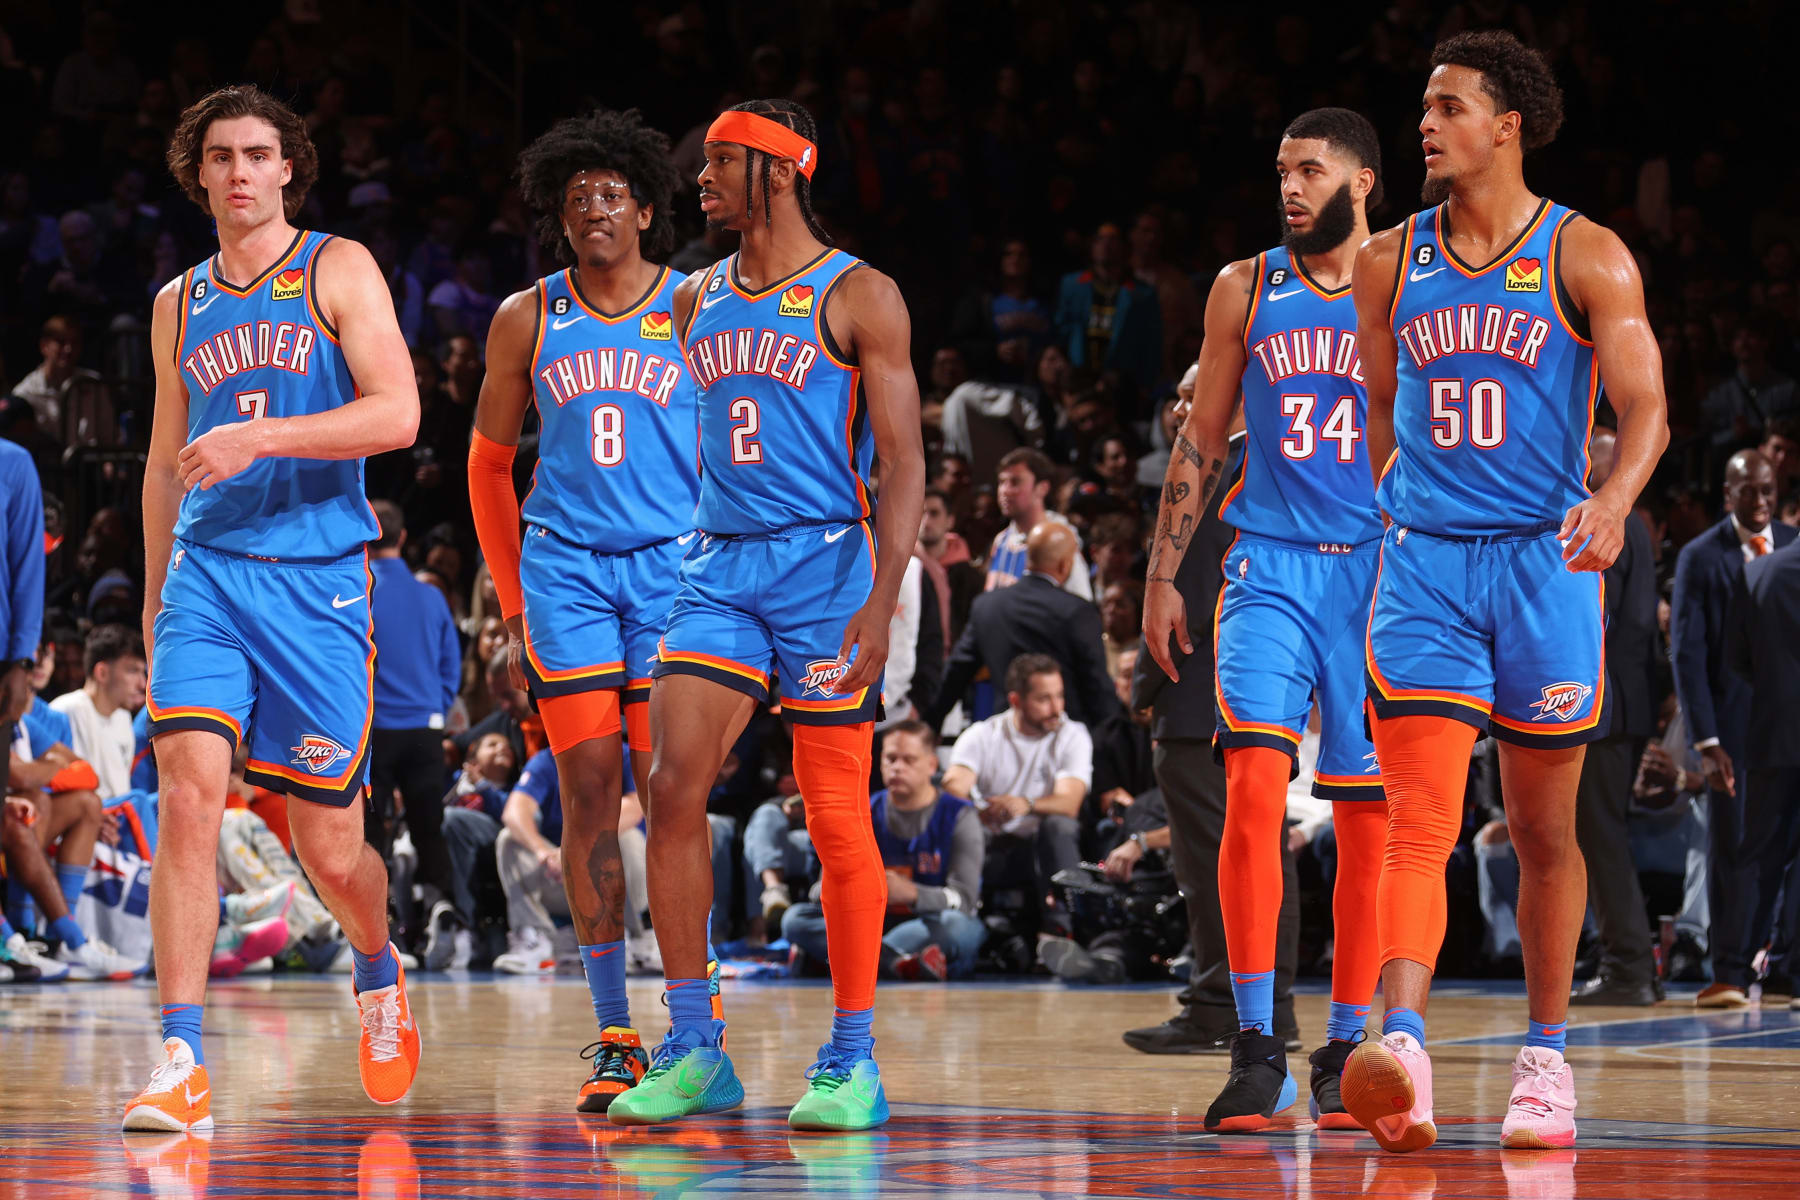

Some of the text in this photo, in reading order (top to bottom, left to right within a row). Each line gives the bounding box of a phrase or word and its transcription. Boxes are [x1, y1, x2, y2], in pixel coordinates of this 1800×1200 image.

[1418, 246, 1431, 263] 6
[710, 277, 722, 291] 6
[1272, 271, 1284, 283] 6
[1507, 279, 1540, 291] Love's
[194, 282, 206, 298] 6
[555, 299, 567, 313] 6
[1398, 304, 1551, 369] THUNDER
[184, 322, 316, 395] THUNDER
[690, 328, 818, 391] THUNDER
[540, 348, 680, 407] THUNDER
[1429, 378, 1506, 450] 50
[592, 403, 624, 467] 8
[730, 396, 763, 464] 2
[1281, 393, 1362, 463] 34
[807, 668, 840, 690] OKC
[1543, 690, 1576, 713] OKC
[298, 745, 332, 759] OKC
